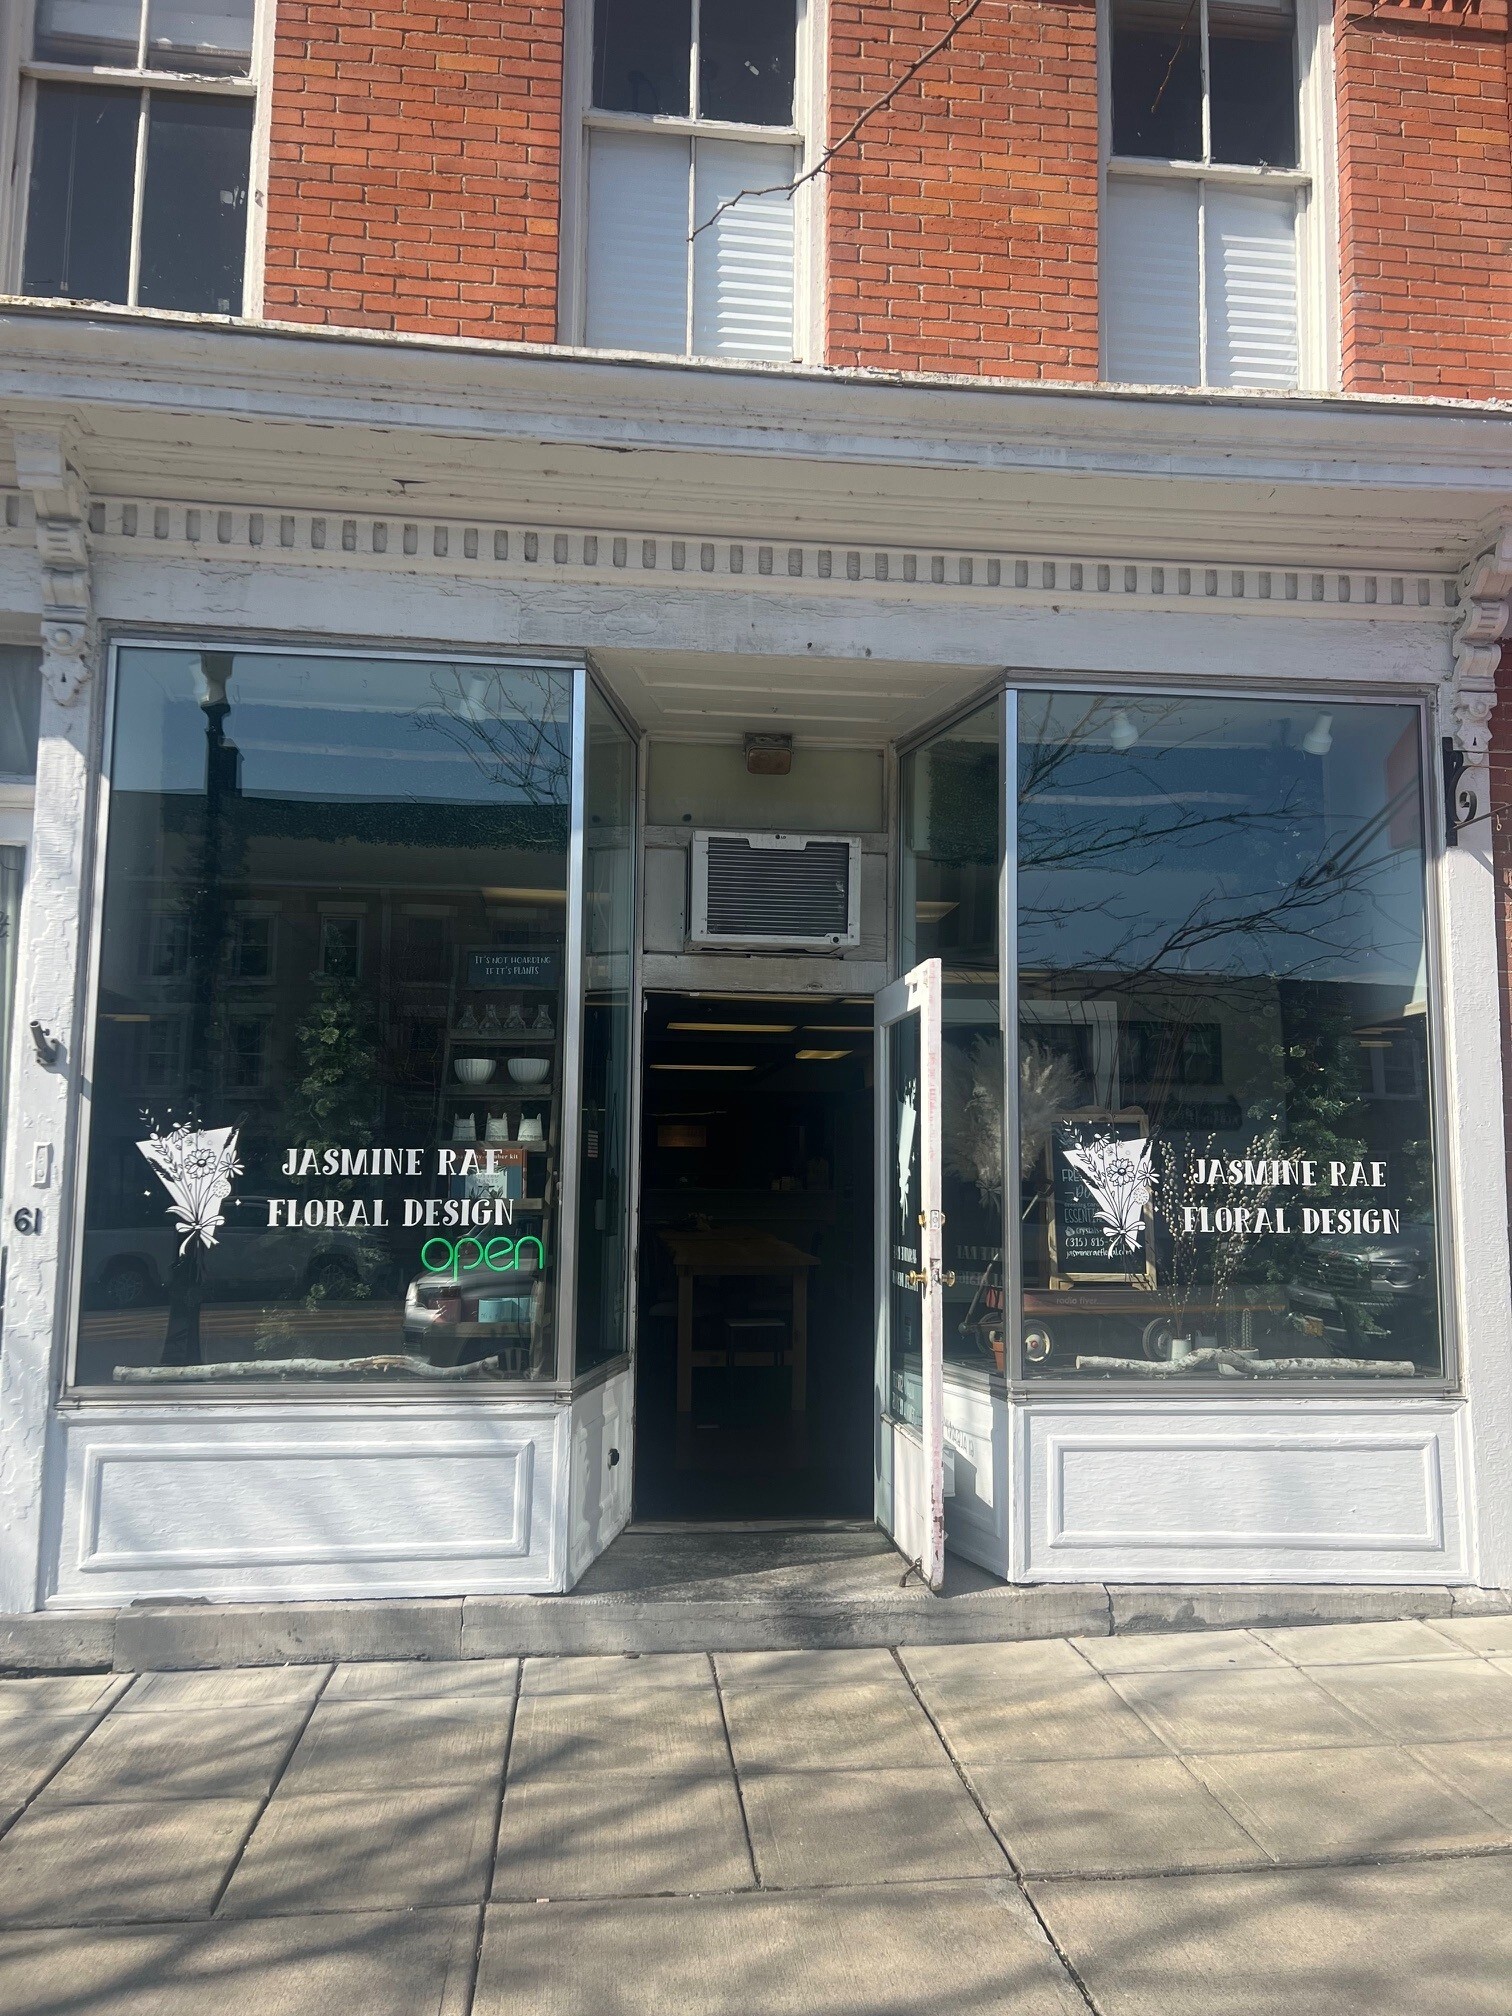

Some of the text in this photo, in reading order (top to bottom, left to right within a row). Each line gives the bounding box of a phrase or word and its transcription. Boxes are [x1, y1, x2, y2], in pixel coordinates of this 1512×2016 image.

[475, 955, 551, 964] IT'S NOT HOARDING
[486, 966, 540, 975] IF IT'S PLANTS
[282, 1148, 503, 1176] JASMINE RAE
[1193, 1158, 1388, 1187] JASMINE RAE
[14, 1207, 43, 1236] 61
[267, 1198, 515, 1227] FLORAL DESIGN
[1182, 1206, 1400, 1235] FLORAL DESIGN
[1065, 1237, 1088, 1247] (315)
[1066, 1247, 1132, 1259] jasmineraefloal.com
[420, 1236, 545, 1281] open
[1056, 1296, 1078, 1305] radio
